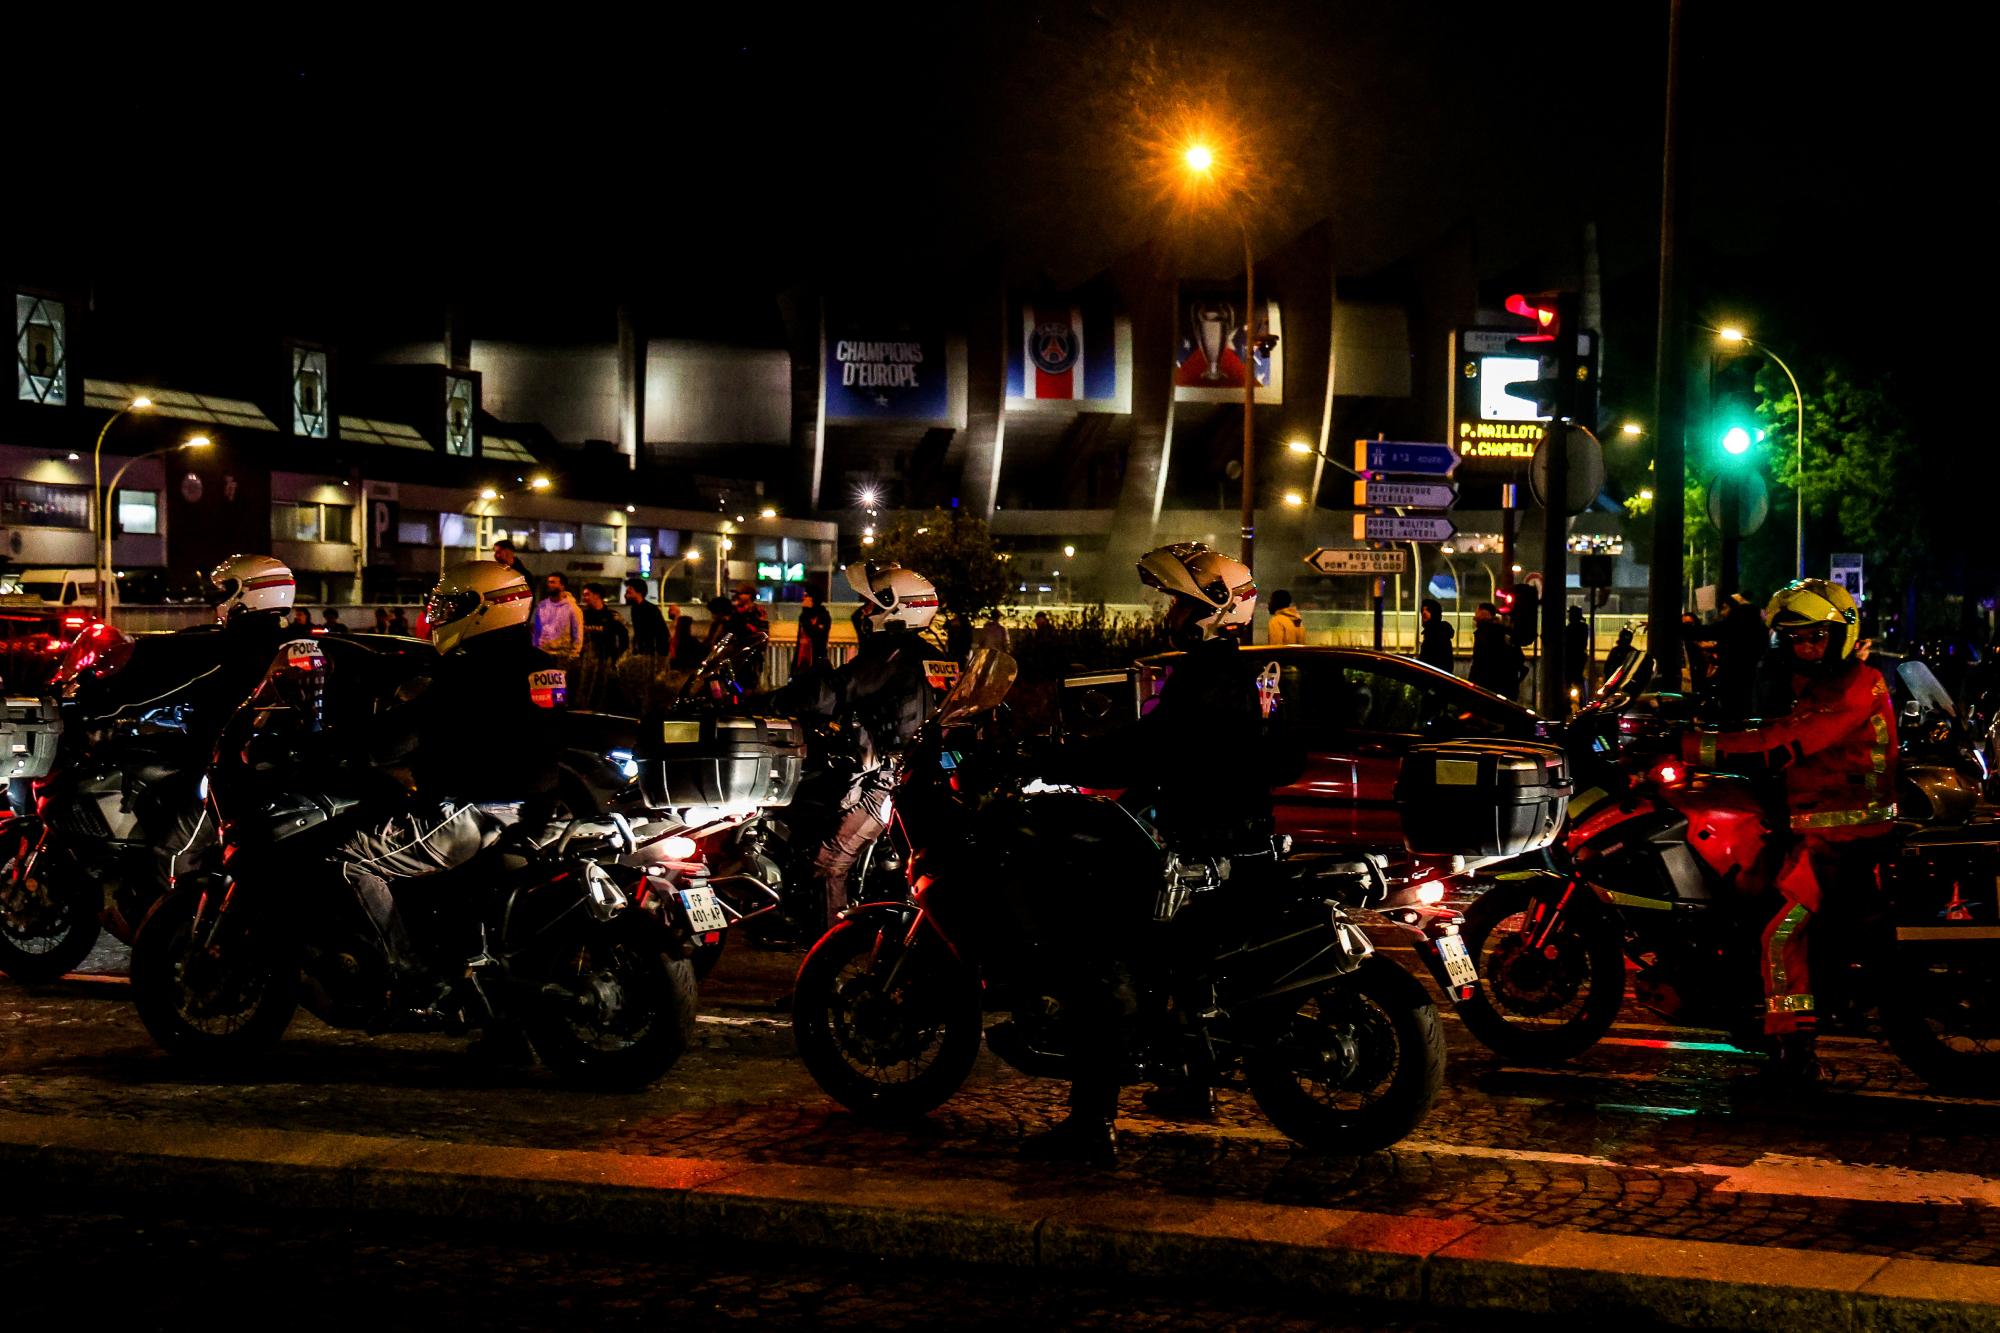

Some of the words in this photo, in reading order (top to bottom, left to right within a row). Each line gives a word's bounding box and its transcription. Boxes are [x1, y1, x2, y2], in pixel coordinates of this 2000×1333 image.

[837, 340, 924, 363] CHAMPIONS
[843, 362, 919, 387] D'EUROPE
[1461, 440, 1534, 457] P.CHAPELL
[1367, 519, 1393, 527] PORTE
[1399, 519, 1435, 528] MOLITOR
[1367, 528, 1393, 537] PORTE
[1348, 553, 1401, 561] BOULOGNE
[1373, 562, 1402, 570] CLOUD
[293, 643, 320, 654] POLICE
[929, 663, 956, 674] POLICE
[533, 673, 562, 685] POLICE
